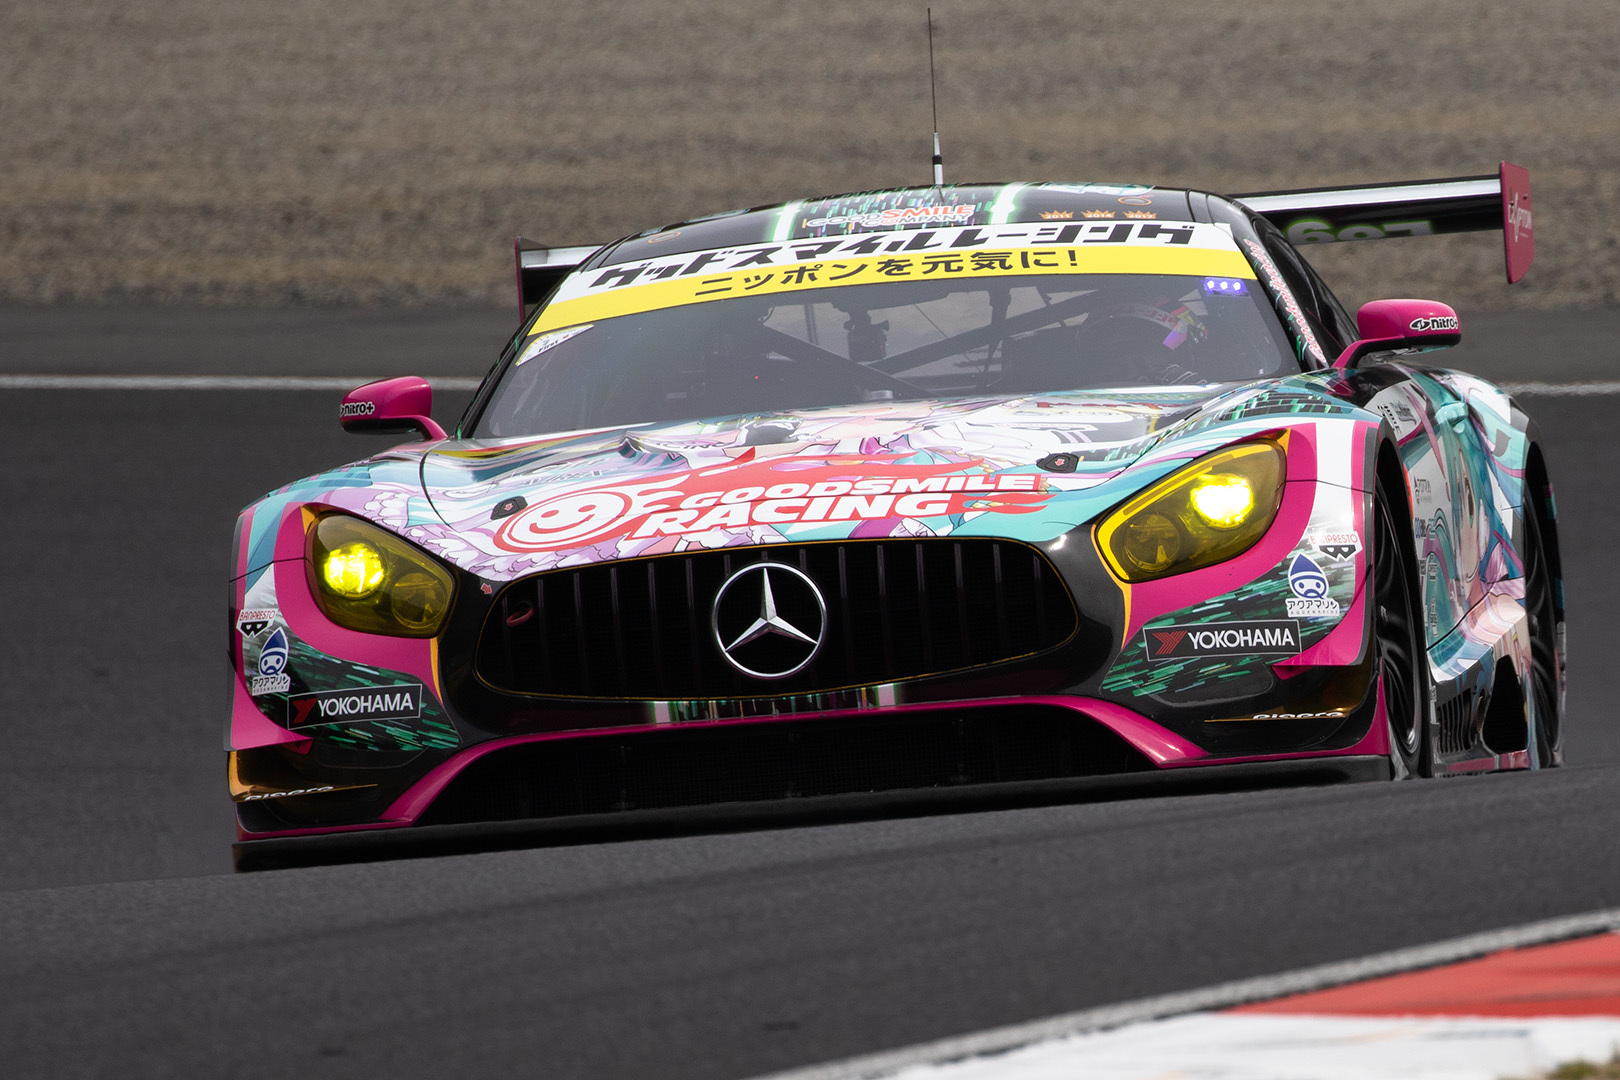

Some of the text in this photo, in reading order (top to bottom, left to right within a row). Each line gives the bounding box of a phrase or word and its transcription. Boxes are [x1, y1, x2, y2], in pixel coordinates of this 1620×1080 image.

[590, 223, 1195, 288] グッドスマイルレーシング
[633, 493, 952, 537] RACING
[1310, 534, 1358, 545] BNPRESTO
[1287, 600, 1337, 610] アクアマリン
[240, 610, 276, 621] BANPRESTO
[1187, 628, 1295, 650] YOKOHAMA
[253, 675, 289, 689] アクアマリン
[318, 692, 414, 717] YOKOHAMA
